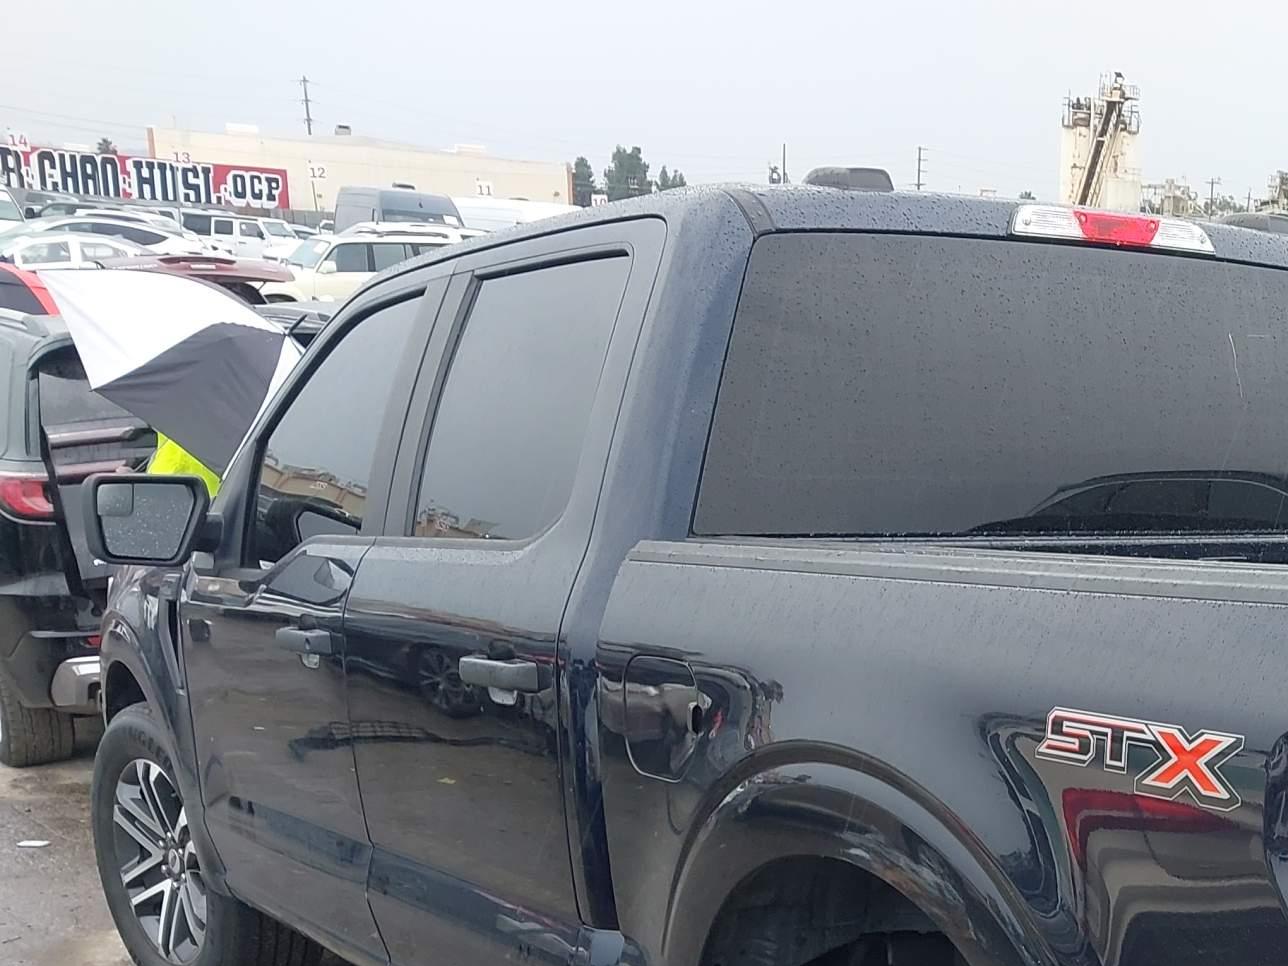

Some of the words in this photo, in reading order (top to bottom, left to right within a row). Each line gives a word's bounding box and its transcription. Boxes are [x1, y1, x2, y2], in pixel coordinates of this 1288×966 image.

[173, 151, 191, 164] 13
[309, 167, 326, 179] 12
[477, 184, 491, 196] 11
[1036, 707, 1244, 811] STX
